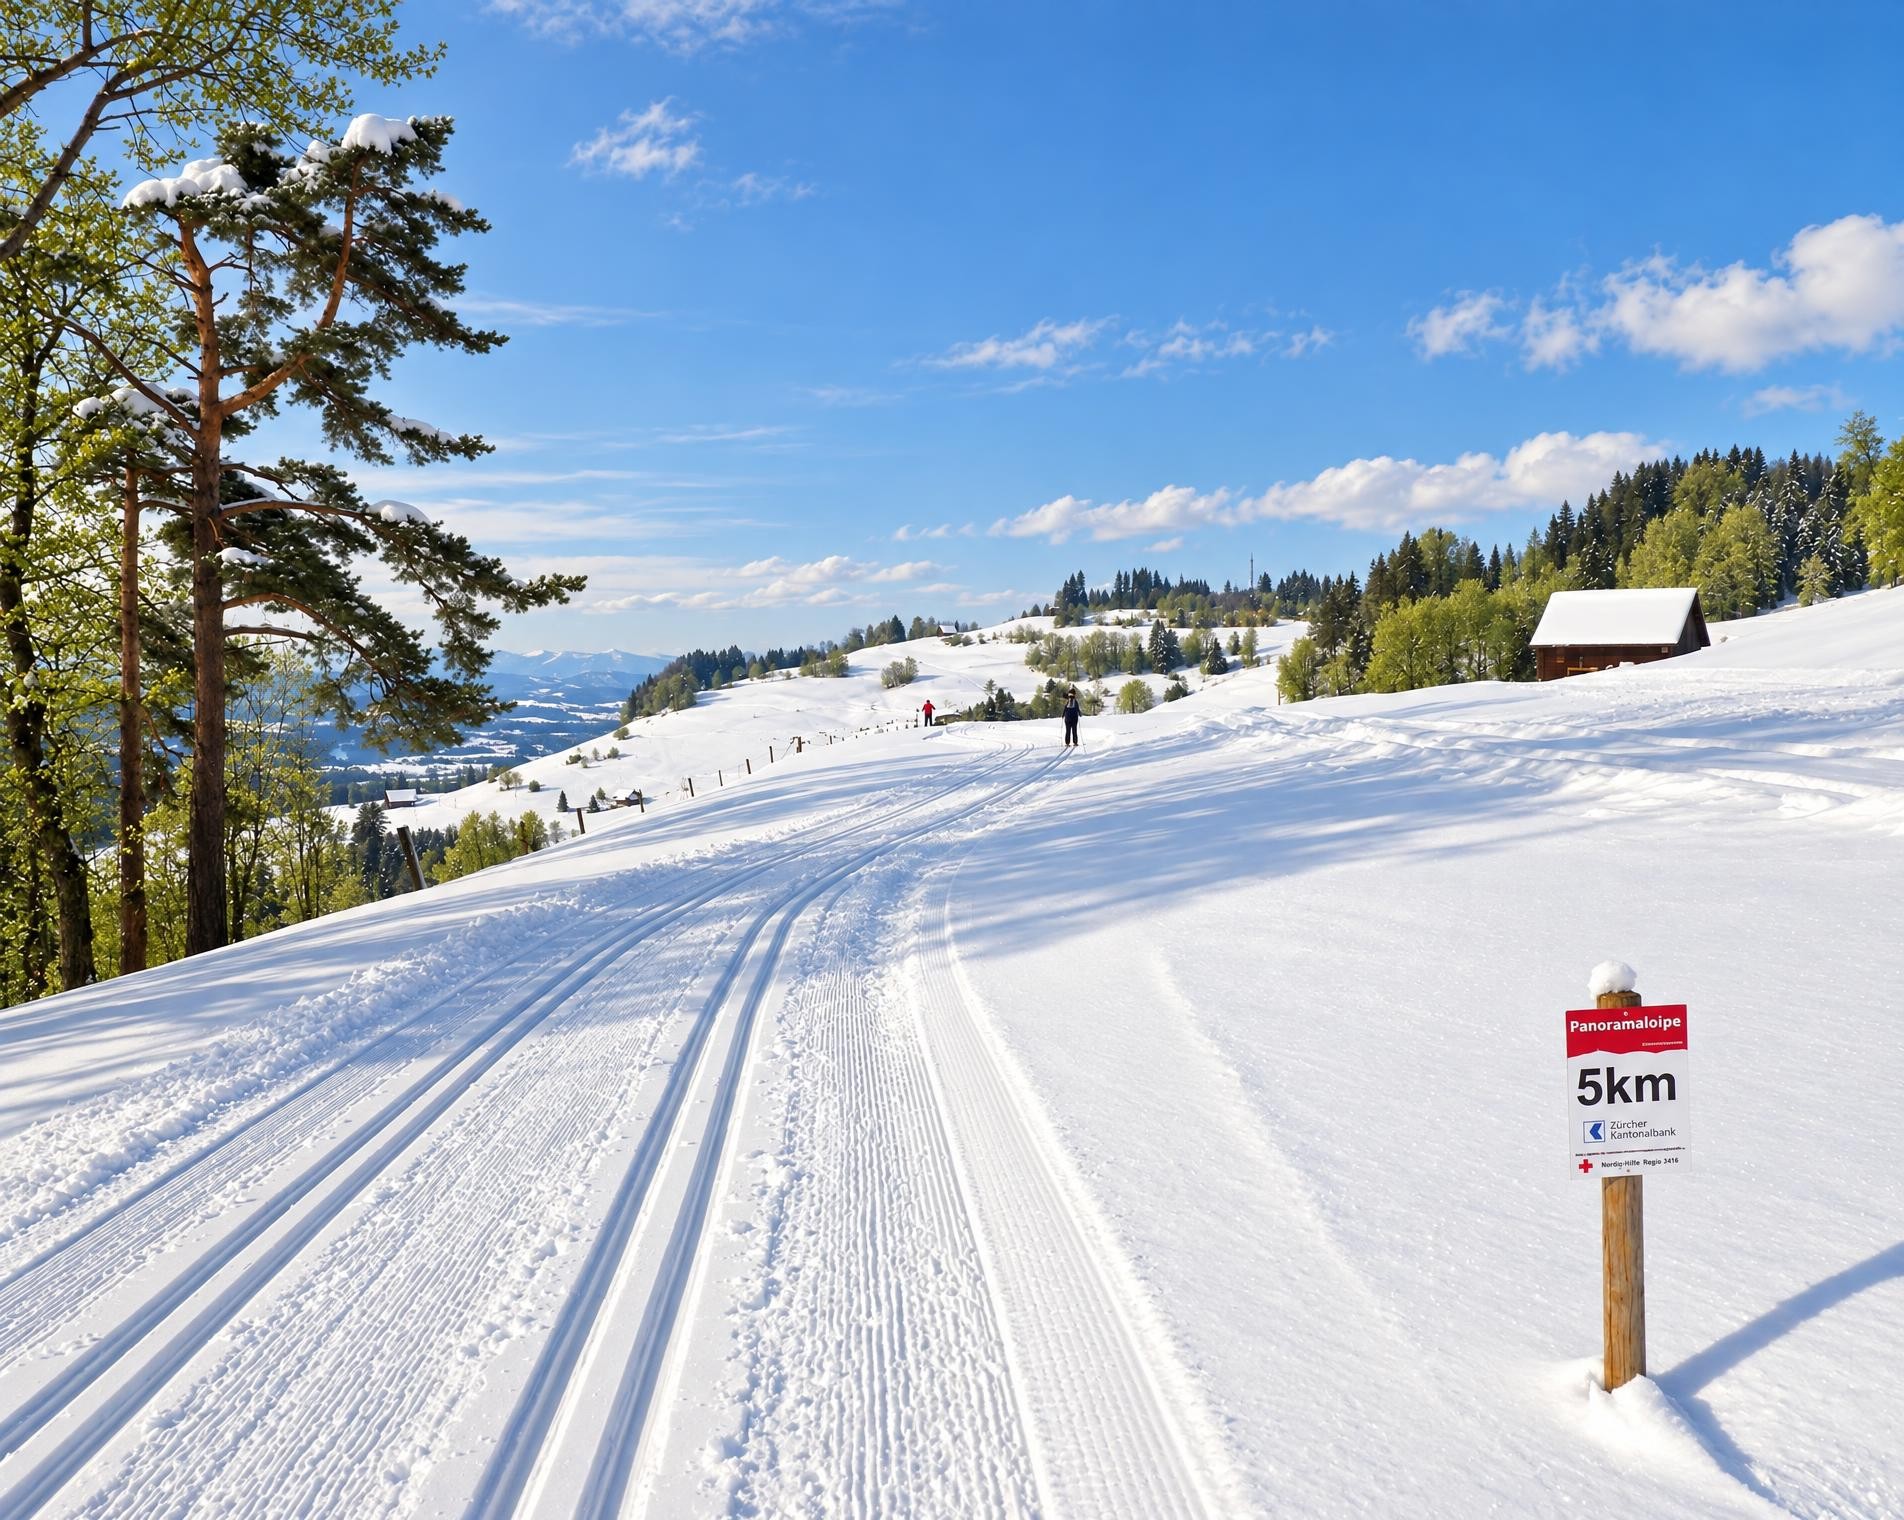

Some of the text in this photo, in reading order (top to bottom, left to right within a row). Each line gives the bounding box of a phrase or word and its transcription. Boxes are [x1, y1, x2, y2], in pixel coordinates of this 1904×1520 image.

[1570, 1016, 1681, 1033] Panoramaloipe
[1577, 1067, 1676, 1106] 5km
[1610, 1120, 1648, 1130] Zürcher
[1610, 1128, 1676, 1140] Kantonalbank
